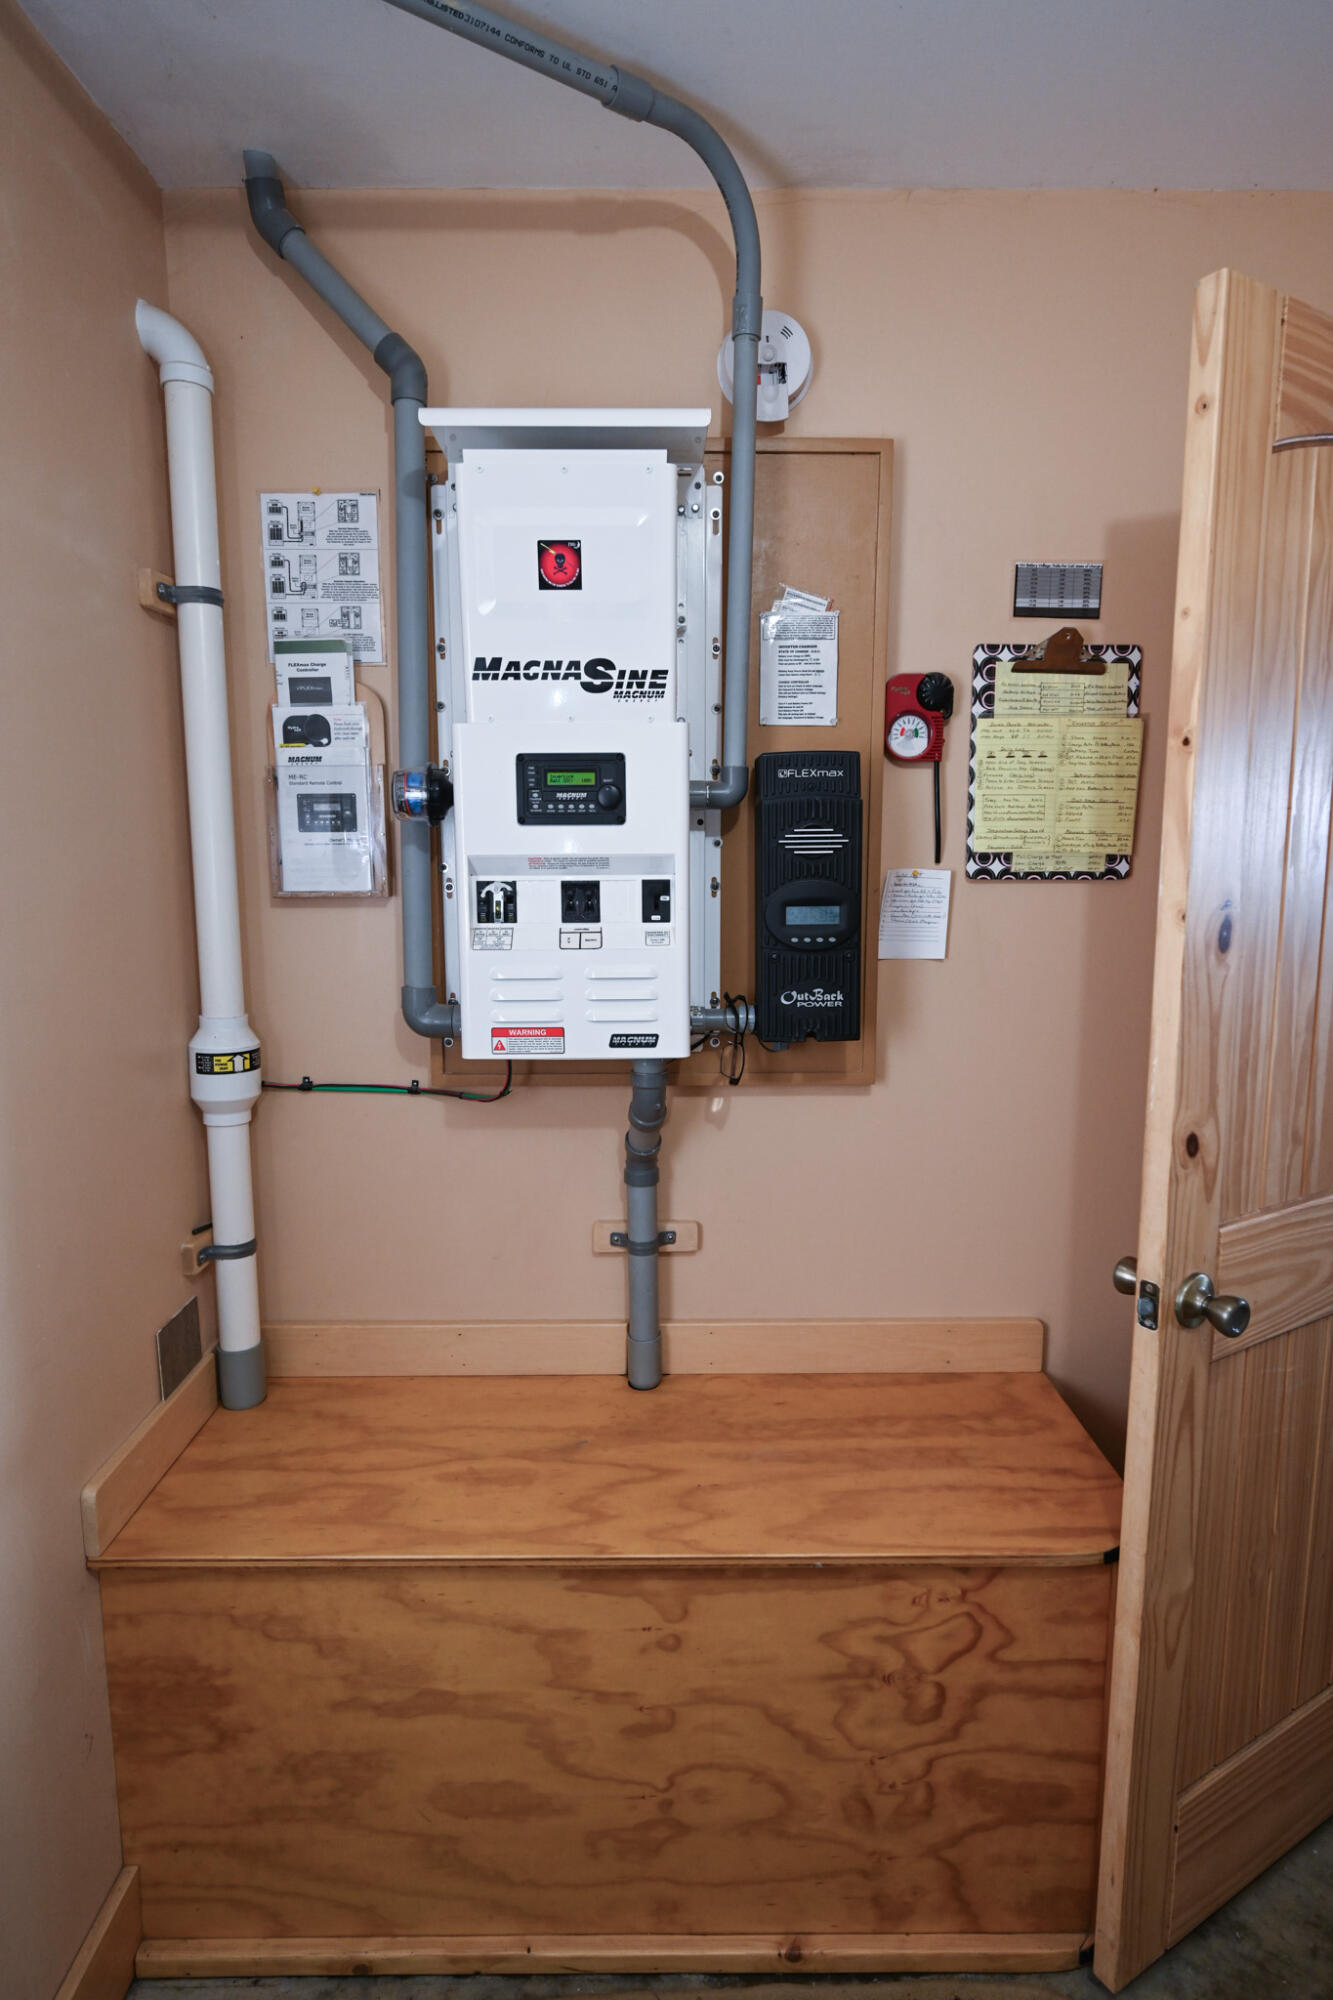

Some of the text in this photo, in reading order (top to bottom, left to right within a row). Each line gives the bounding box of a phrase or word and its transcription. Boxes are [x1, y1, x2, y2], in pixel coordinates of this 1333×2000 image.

[504, 33, 545, 58] CONFORMS
[549, 54, 560, 65] TO
[562, 61, 572, 72] UL
[576, 67, 591, 80] STD
[613, 690, 665, 699] MAGNUM
[787, 768, 844, 778] FLEXmax
[780, 988, 844, 1005] OutBack
